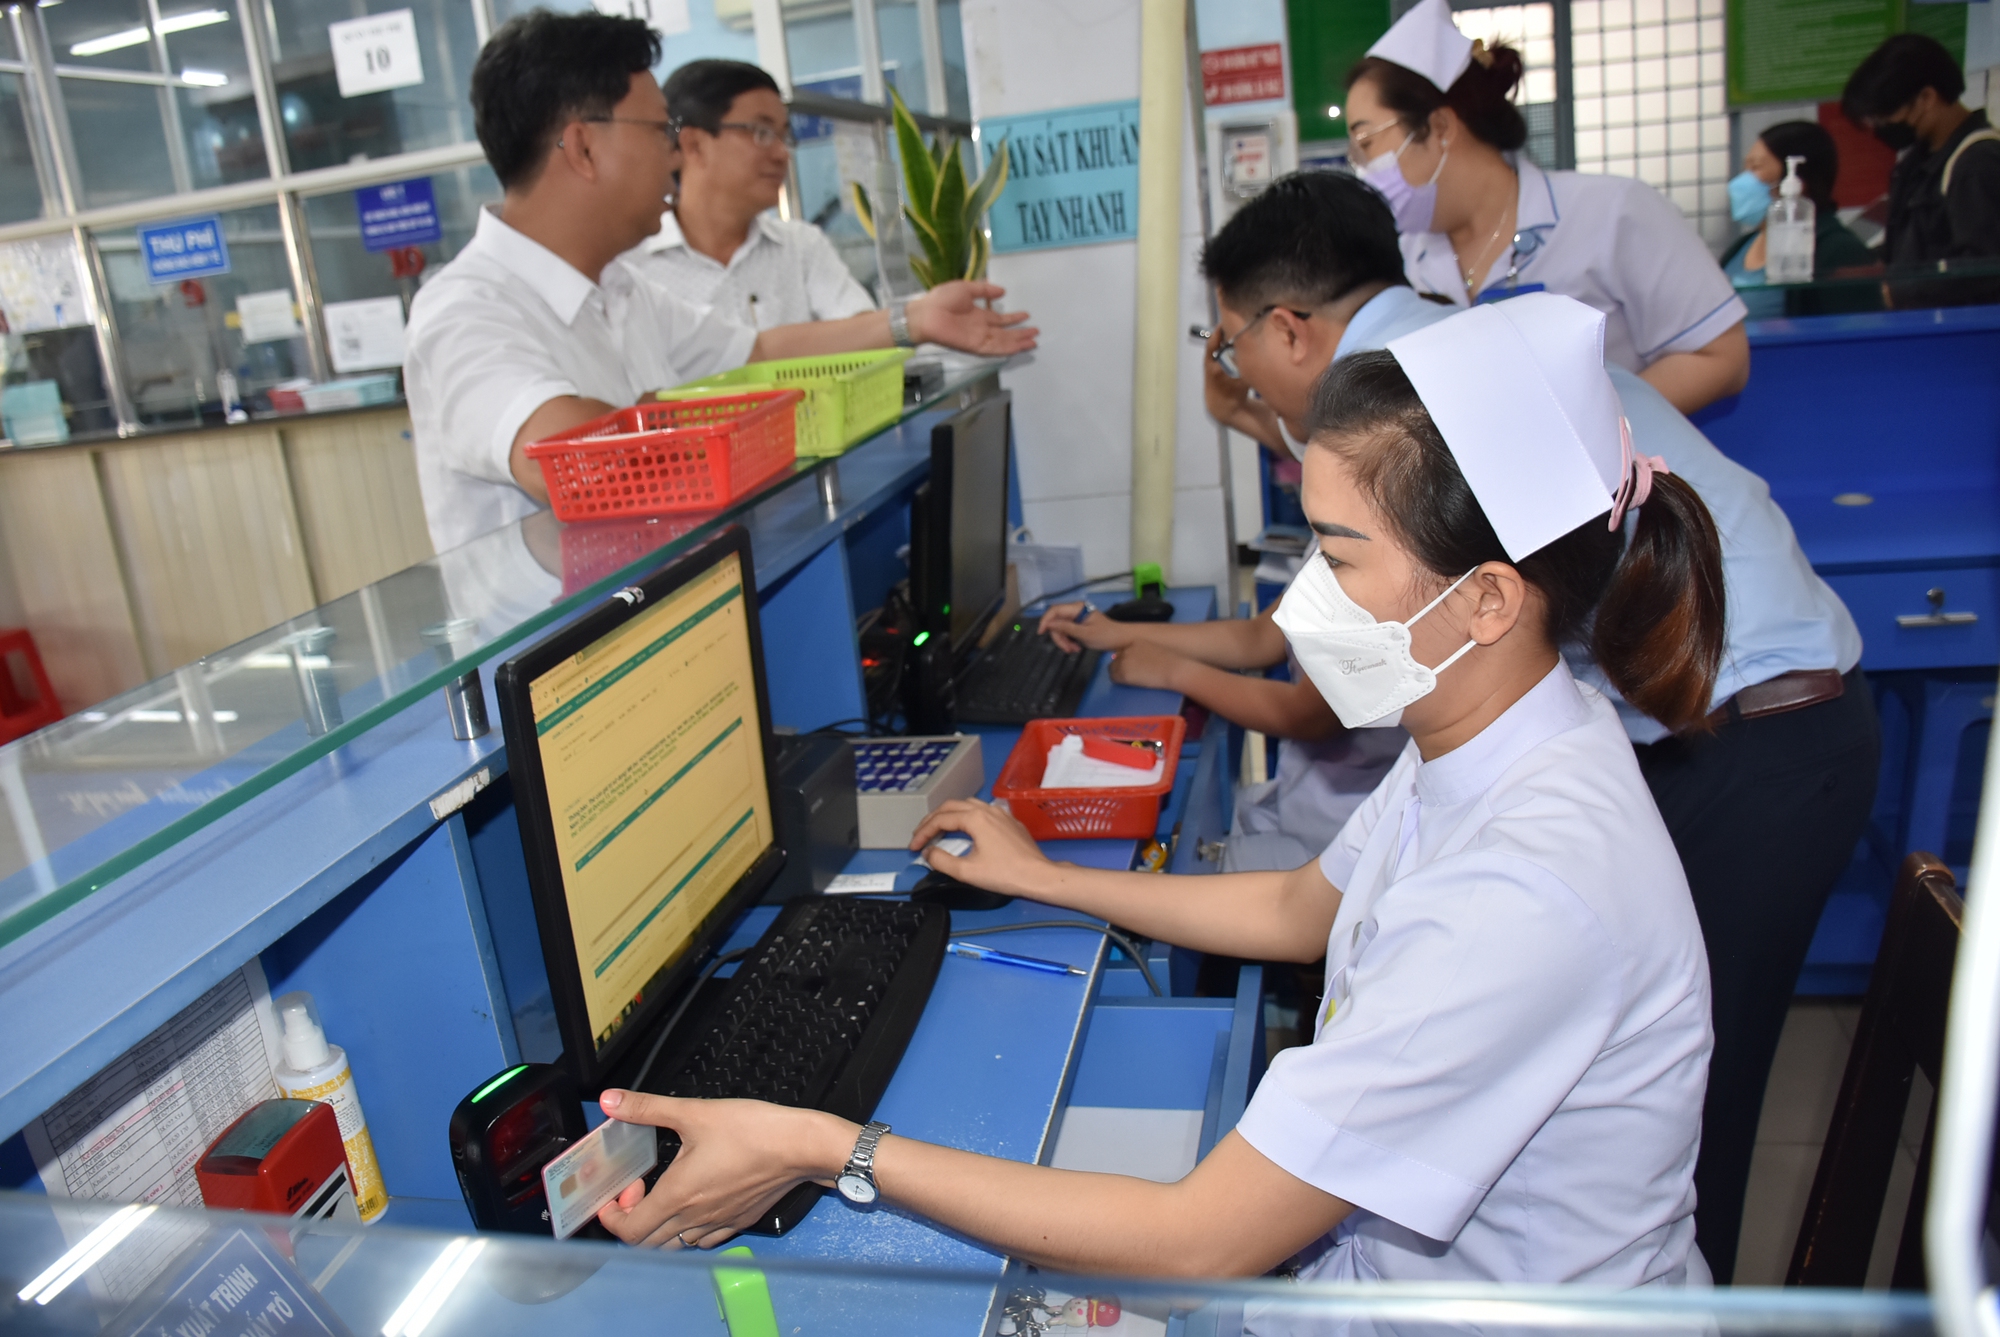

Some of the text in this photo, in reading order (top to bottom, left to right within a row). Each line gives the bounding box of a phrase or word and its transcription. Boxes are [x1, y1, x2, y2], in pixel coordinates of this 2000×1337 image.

[365, 45, 391, 75] 10
[1032, 120, 1068, 177] SÁT
[1017, 190, 1127, 244] TAY NHANH
[209, 1263, 259, 1312] TRÌNH
